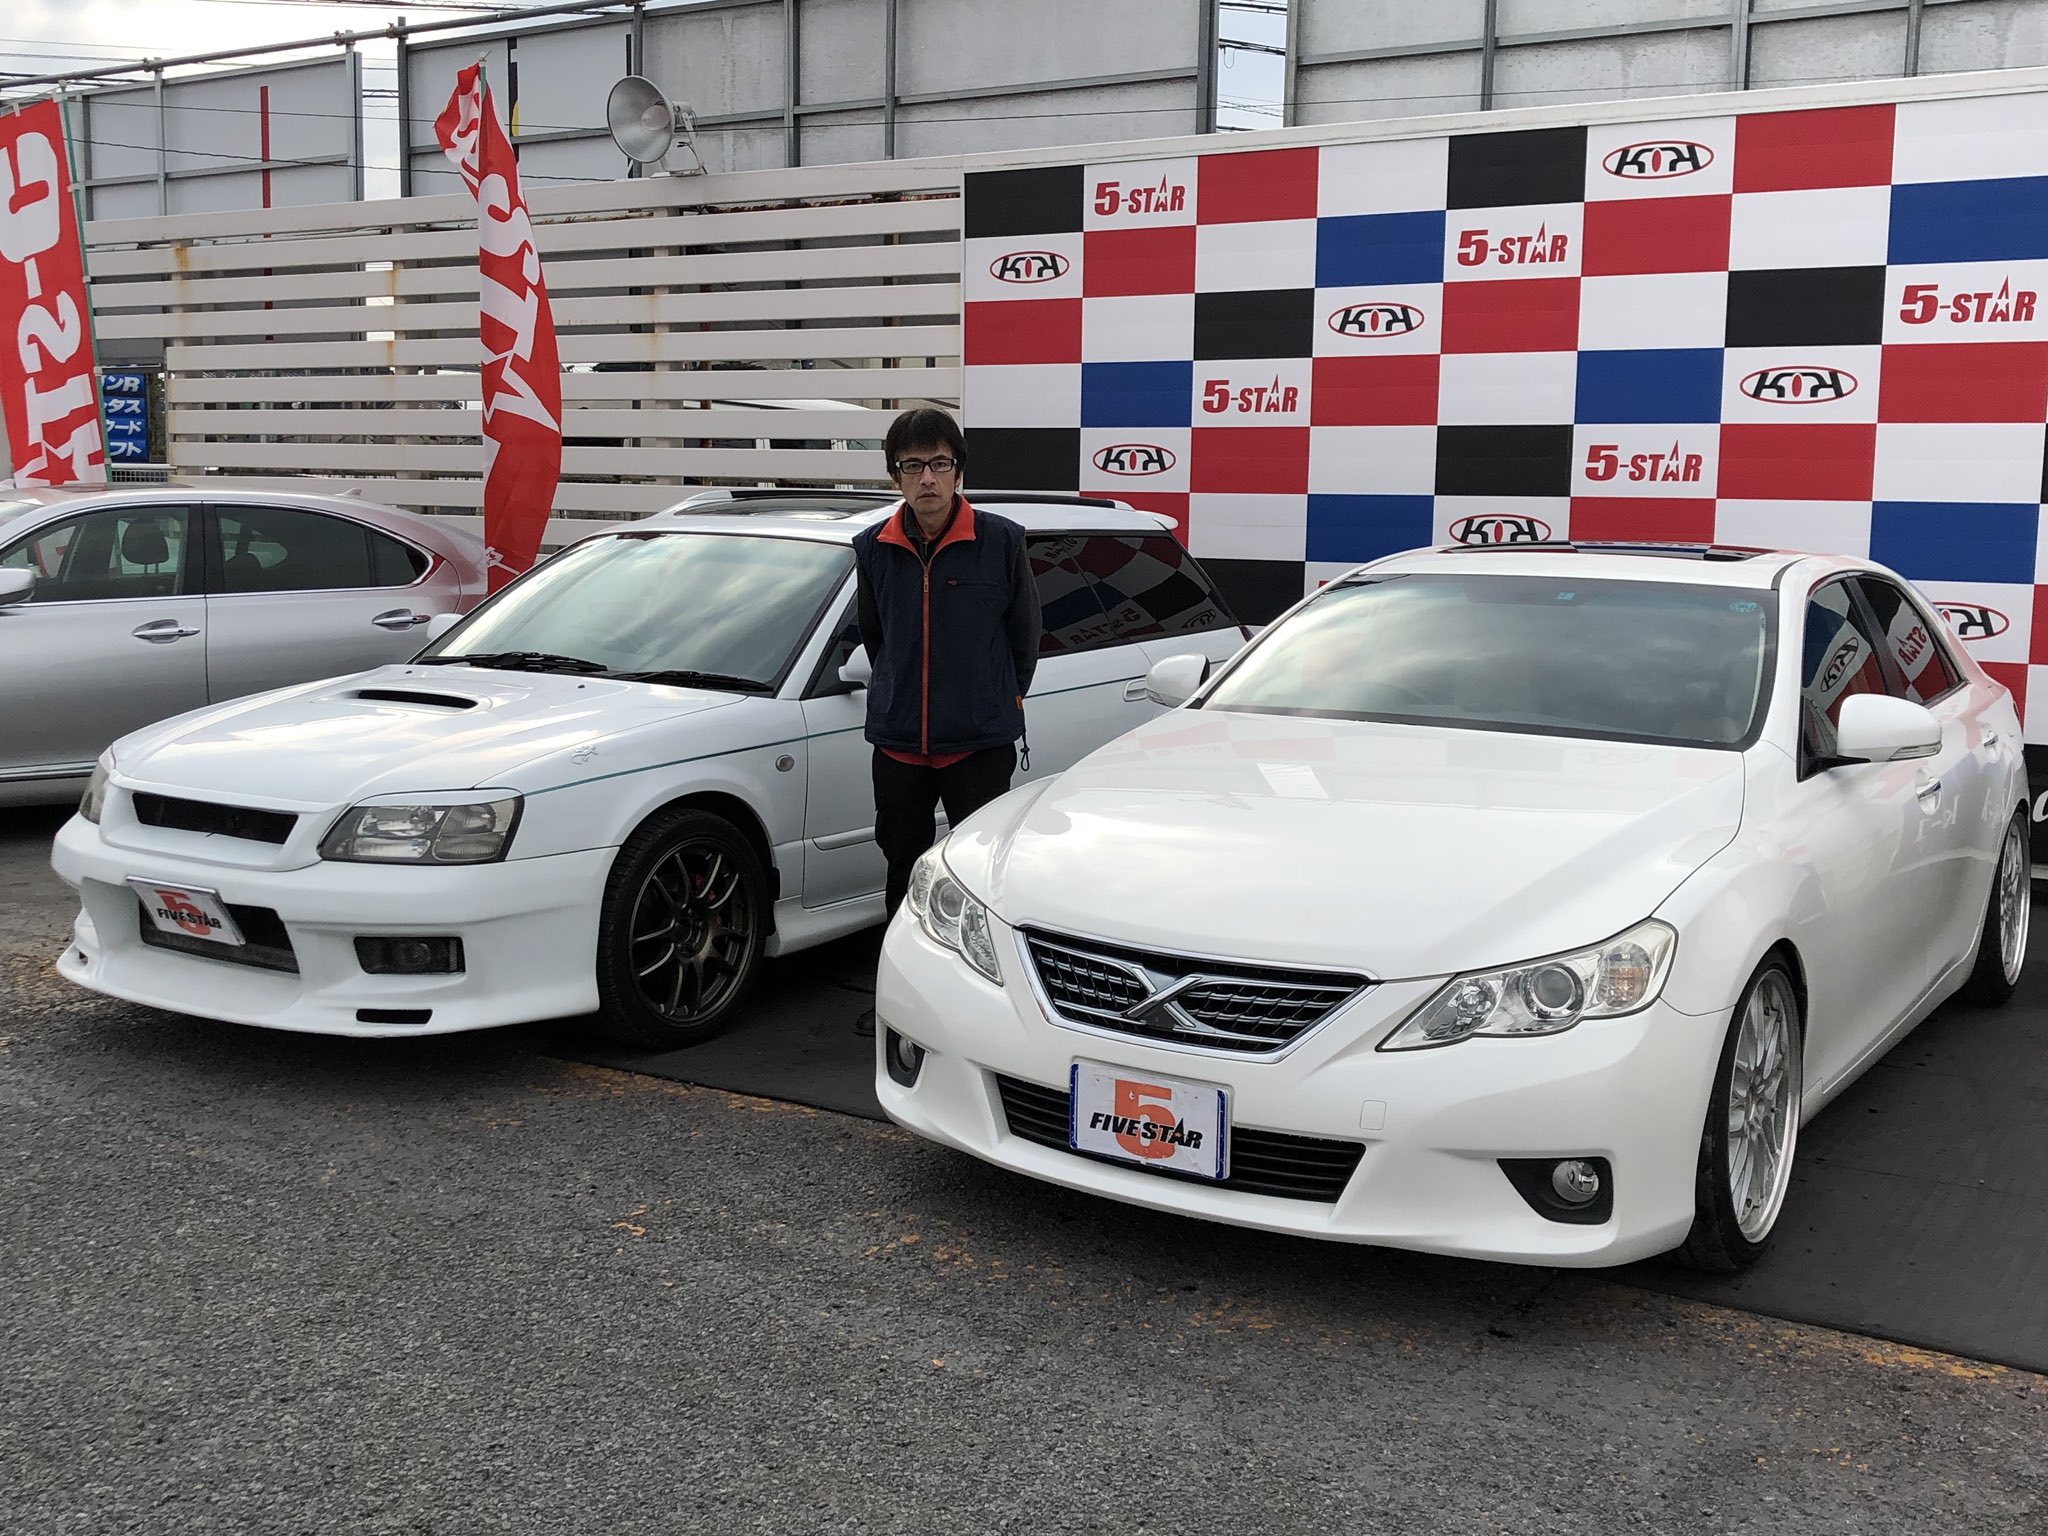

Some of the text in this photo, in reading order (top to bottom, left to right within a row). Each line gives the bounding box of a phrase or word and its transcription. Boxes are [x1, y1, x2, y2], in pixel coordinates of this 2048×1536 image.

[1094, 174, 1185, 216] 5-STAR
[1457, 221, 1569, 267] 5-STAR
[1899, 276, 2037, 324] 5-STAR
[102, 375, 140, 392] ンR
[1202, 374, 1298, 414] 5-STAR
[104, 399, 141, 414] タス
[1585, 440, 1703, 482] 5-STAR
